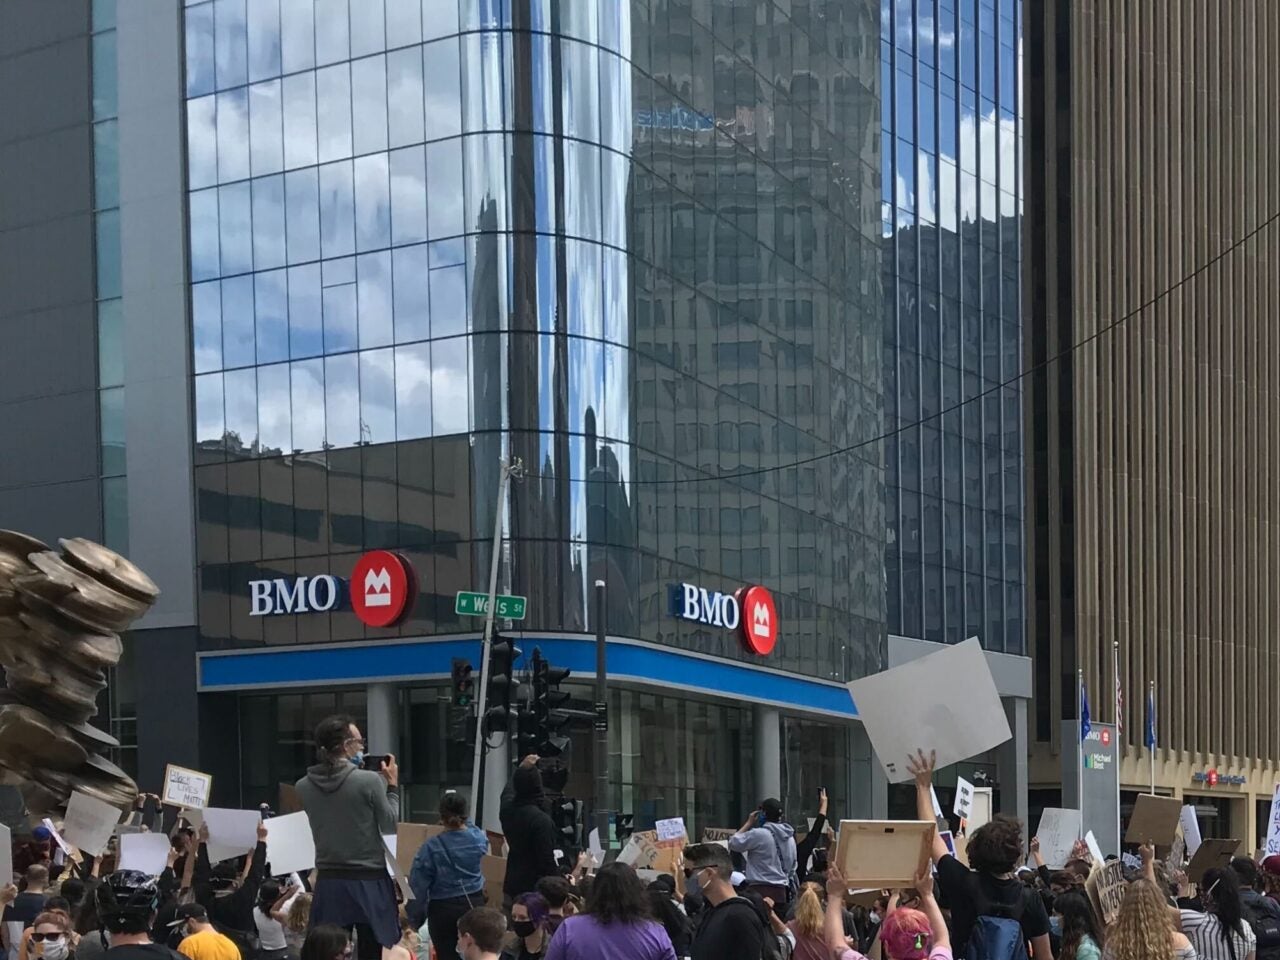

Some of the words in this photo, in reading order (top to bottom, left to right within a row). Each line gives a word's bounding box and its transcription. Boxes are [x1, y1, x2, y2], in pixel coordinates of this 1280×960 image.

[249, 574, 336, 616] BMO
[474, 597, 507, 614] Wels
[682, 582, 739, 629] BMO
